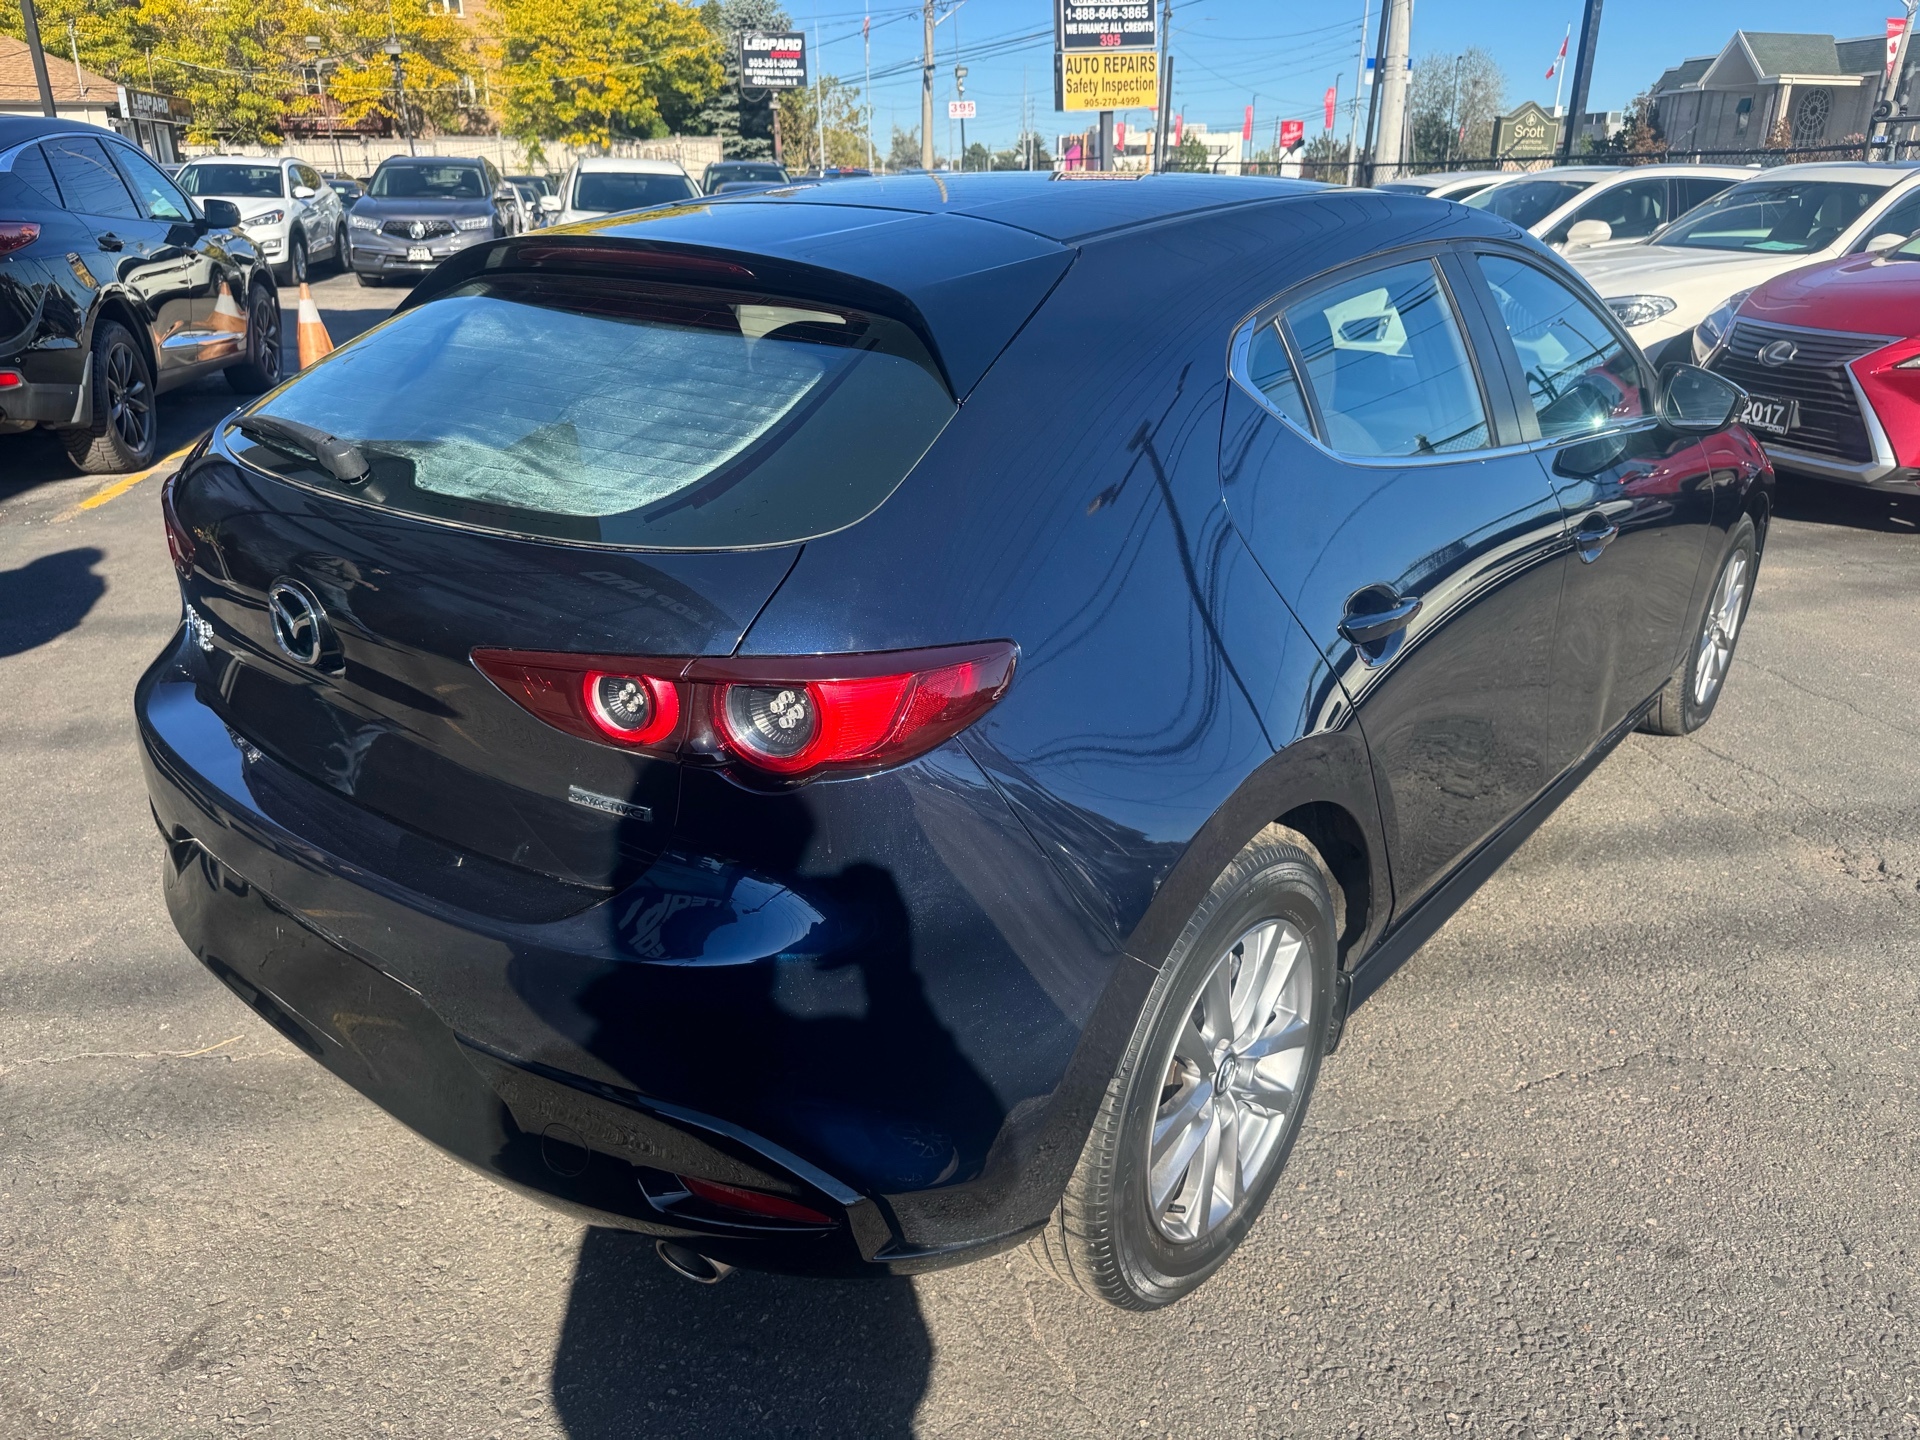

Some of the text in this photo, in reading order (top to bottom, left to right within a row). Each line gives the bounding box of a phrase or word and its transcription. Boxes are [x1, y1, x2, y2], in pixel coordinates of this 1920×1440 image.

[1065, 6, 1149, 20] 1-888-646-3865
[1066, 21, 1154, 34] WE FINANCE ALL CREDITS
[743, 38, 803, 51] LEOPARD
[1100, 34, 1121, 46] 395
[1066, 56, 1156, 75] AUTO REPAIRS
[1066, 76, 1154, 97] Safety Inspection
[131, 92, 169, 113] LEOPARD
[951, 103, 974, 113] 395
[1083, 97, 1140, 107] 905-270-4999
[1514, 124, 1546, 138] Scott
[1741, 401, 1784, 424] 2017
